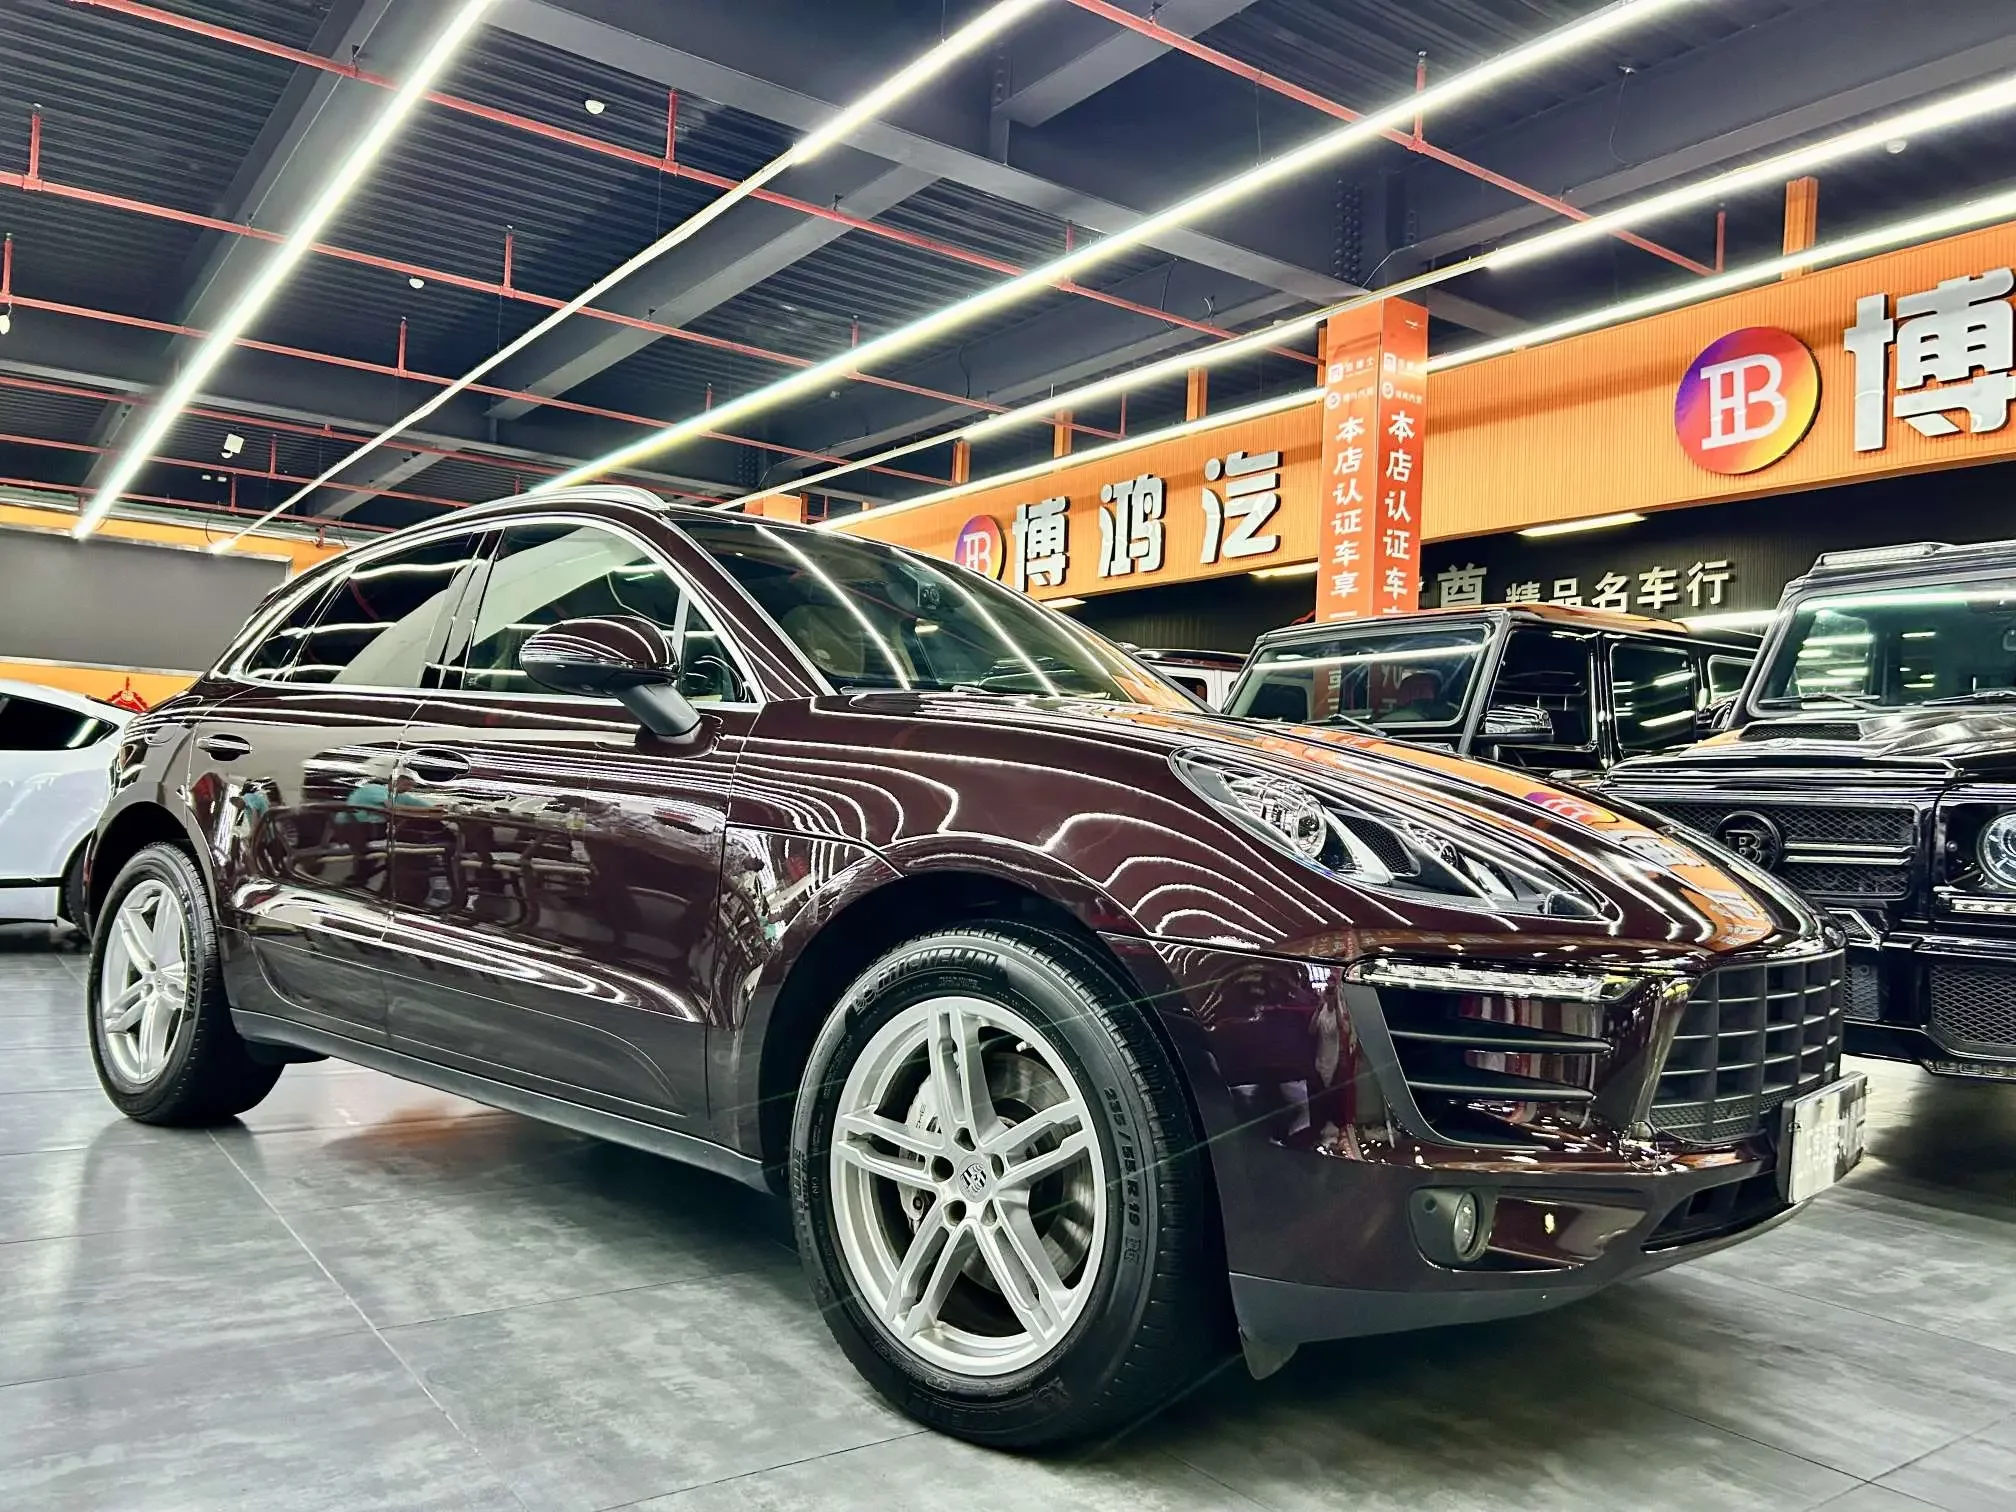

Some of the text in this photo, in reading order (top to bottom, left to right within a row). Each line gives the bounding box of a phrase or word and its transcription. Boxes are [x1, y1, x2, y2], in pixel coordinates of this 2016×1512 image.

[1844, 266, 2016, 452] 博
[1012, 451, 1279, 592] 博鸿汽
[1505, 559, 1730, 612] 精品名车行
